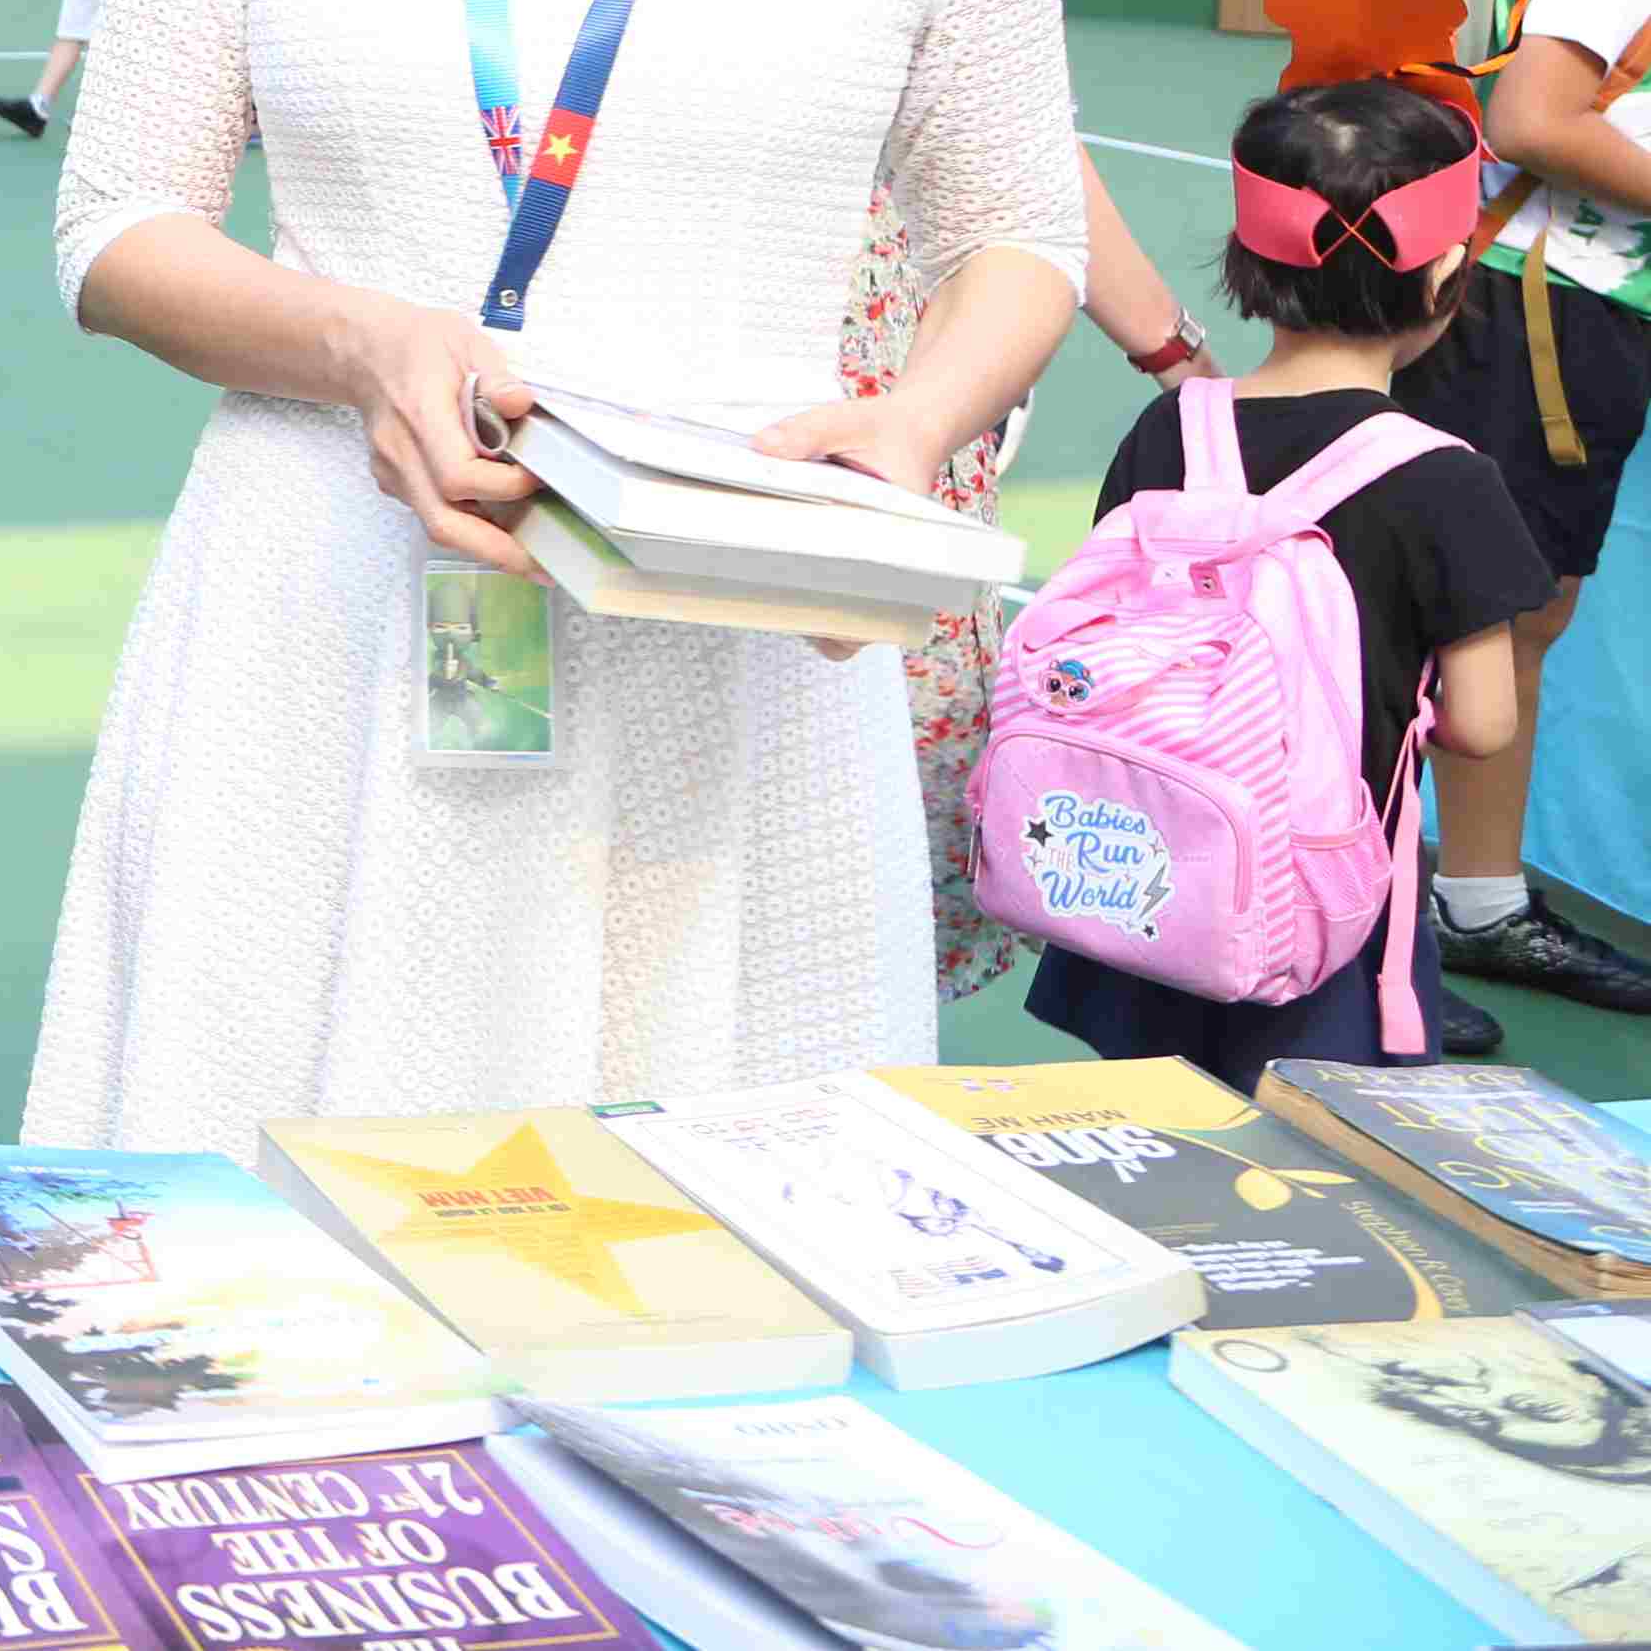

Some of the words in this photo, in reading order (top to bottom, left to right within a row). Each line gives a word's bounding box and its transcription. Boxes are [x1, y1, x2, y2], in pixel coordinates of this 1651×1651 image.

[1044, 794, 1147, 835] Babies
[1066, 832, 1146, 872] Run
[1041, 870, 1138, 910] World
[103, 1468, 371, 1530] CENTURY
[210, 1524, 359, 1576] THE
[351, 1517, 447, 1568] OF
[176, 1560, 581, 1642] BUSINESS
